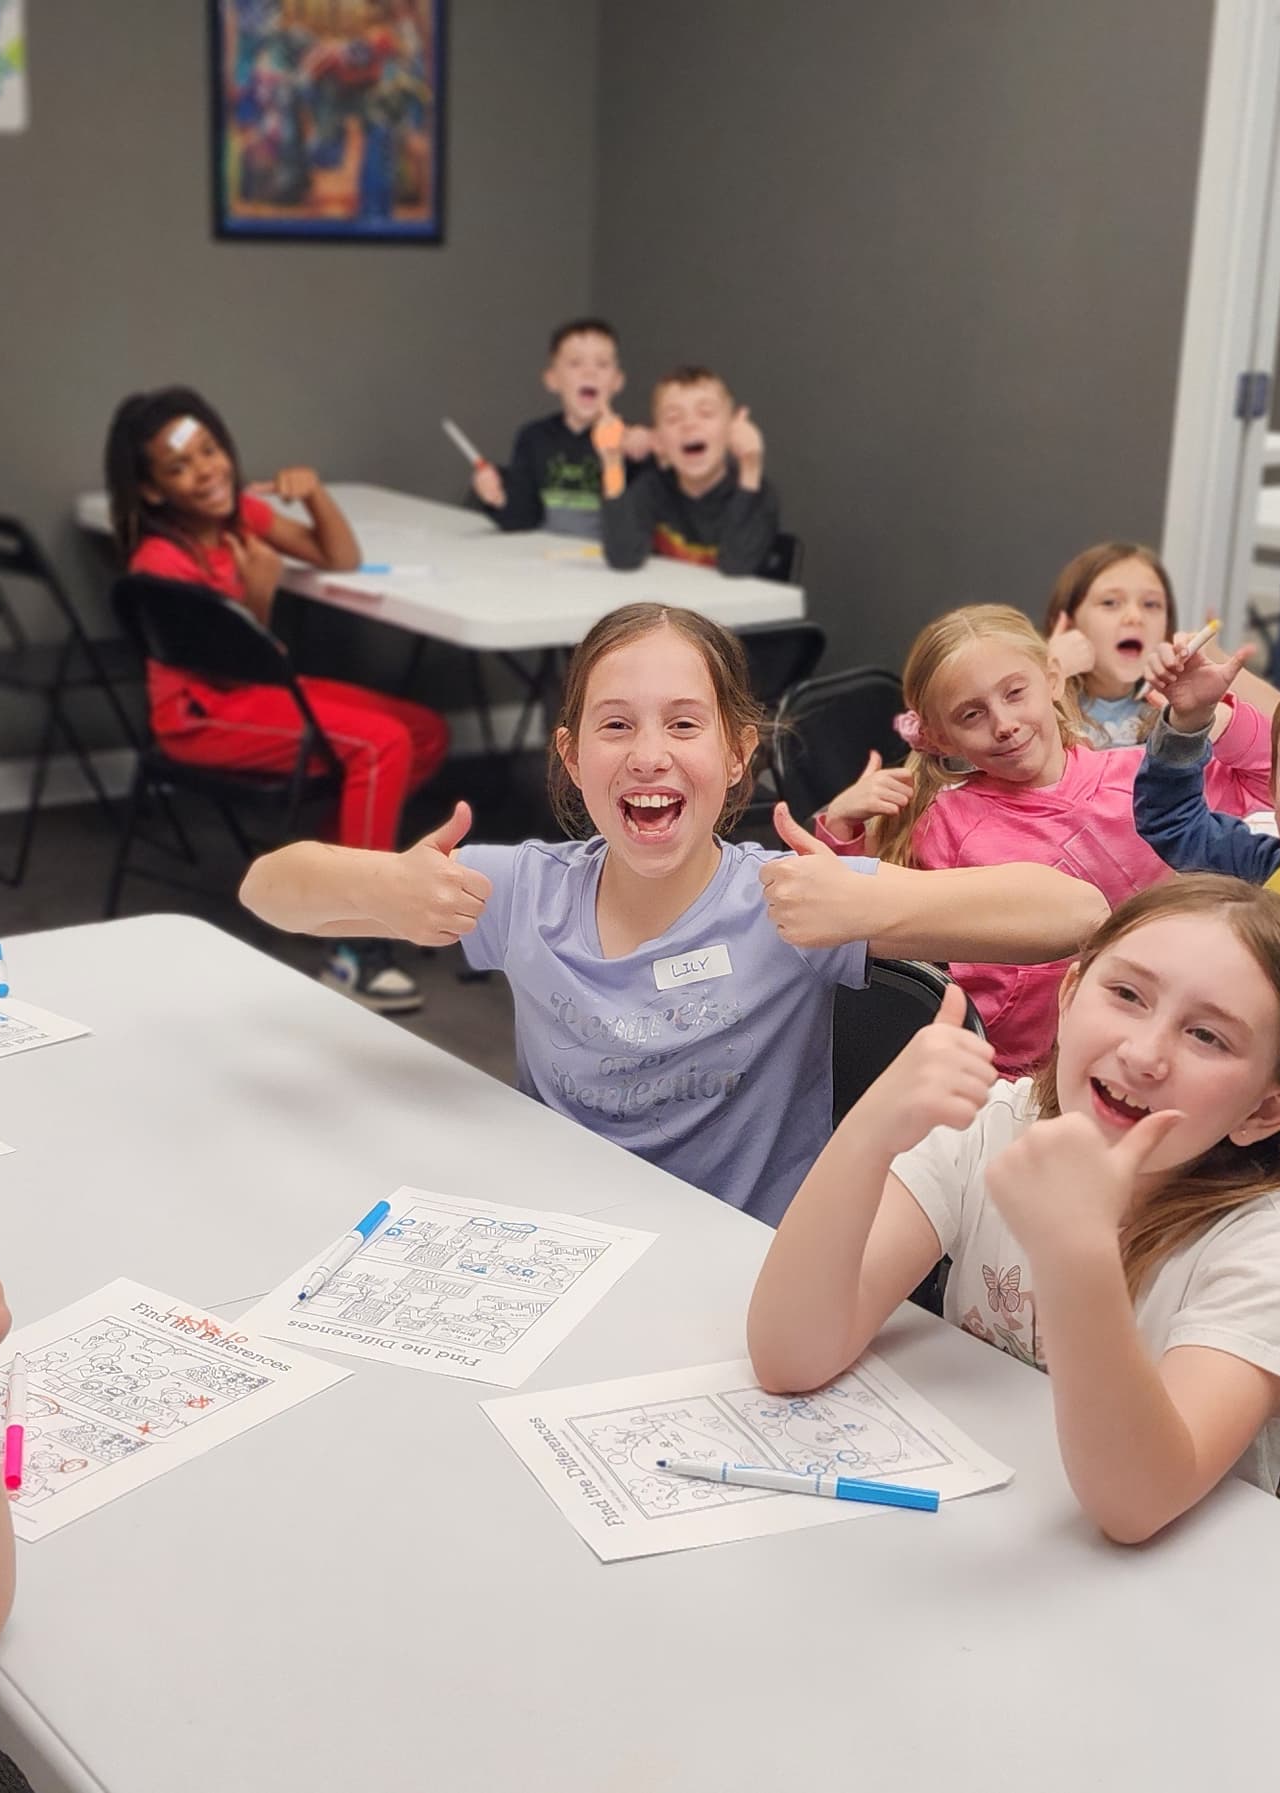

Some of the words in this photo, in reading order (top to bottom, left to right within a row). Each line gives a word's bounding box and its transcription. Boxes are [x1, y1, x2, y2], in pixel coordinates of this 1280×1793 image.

[671, 956, 709, 978] LILY
[130, 1301, 171, 1325] Find
[169, 1318, 197, 1336] the
[196, 1330, 293, 1372] Differences
[287, 1319, 399, 1350] Differences
[401, 1342, 432, 1356] the
[435, 1350, 482, 1368] Find
[529, 1417, 586, 1479] Differences
[579, 1479, 602, 1498] the
[589, 1499, 625, 1527] Find
